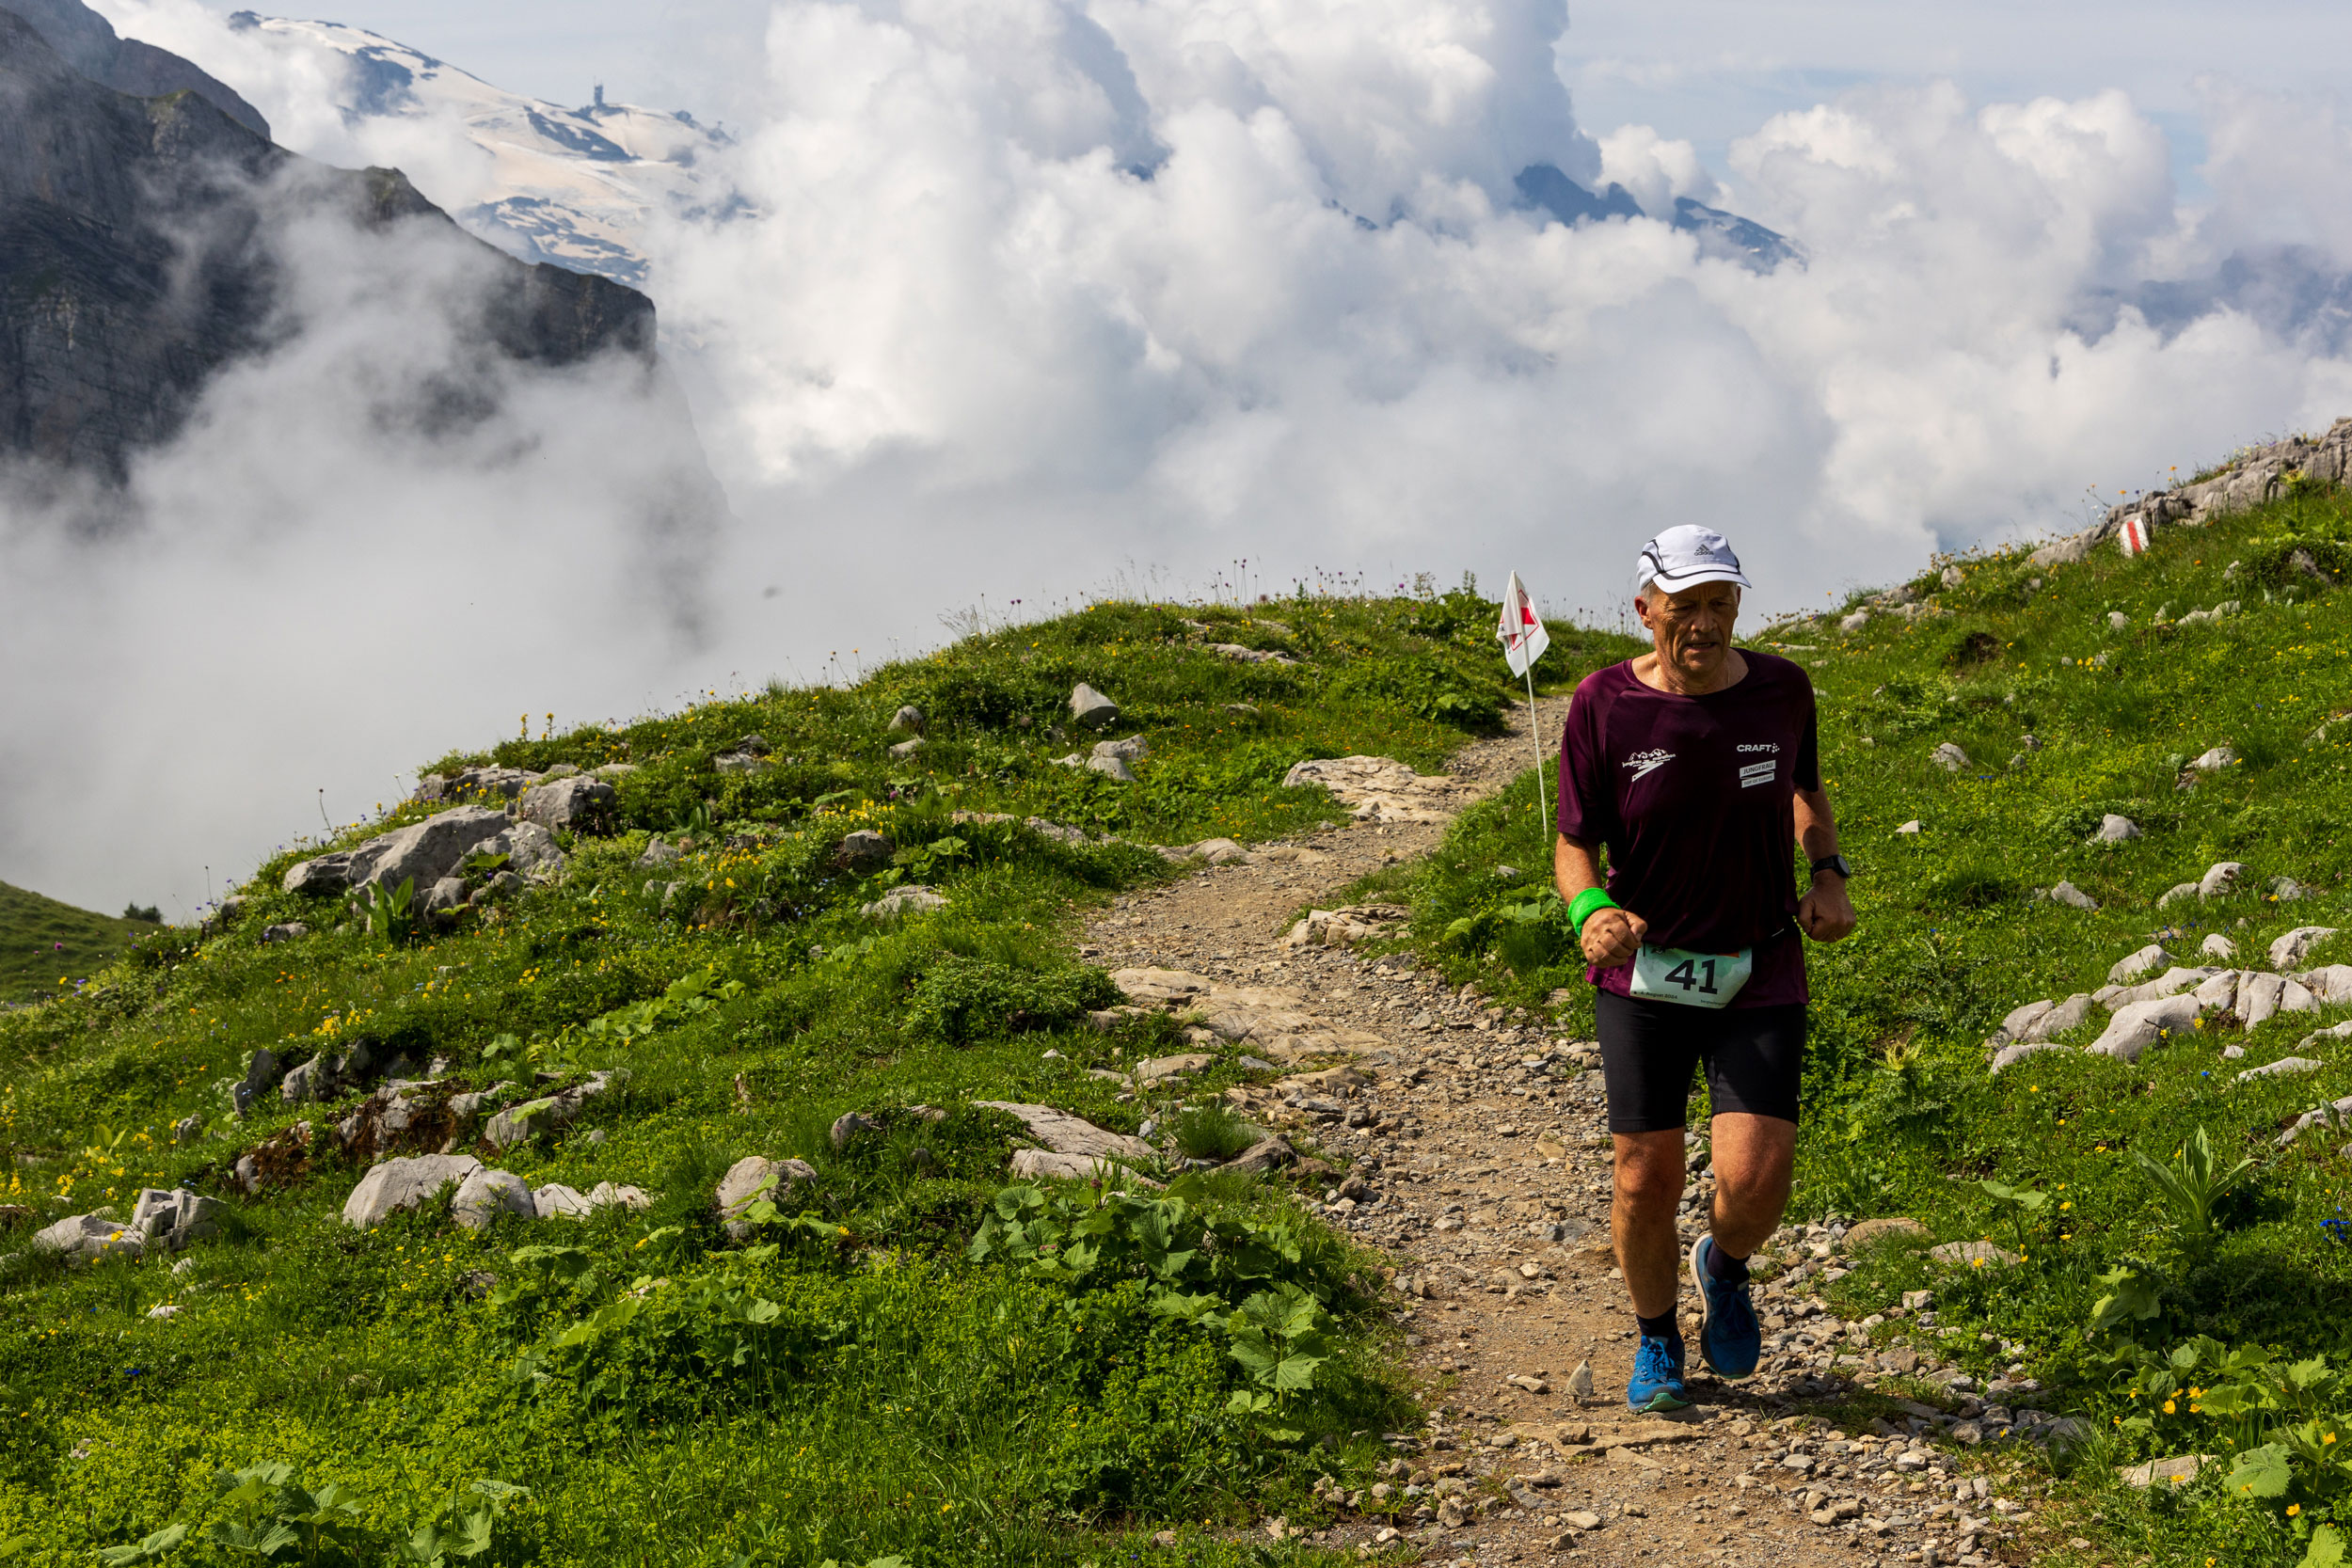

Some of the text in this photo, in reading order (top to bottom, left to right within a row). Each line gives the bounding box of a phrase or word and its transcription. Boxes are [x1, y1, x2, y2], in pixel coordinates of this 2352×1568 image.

[1737, 744, 1772, 752] CRAFT
[1743, 762, 1773, 775] JUNGFRAU
[1664, 958, 1718, 995] 41
